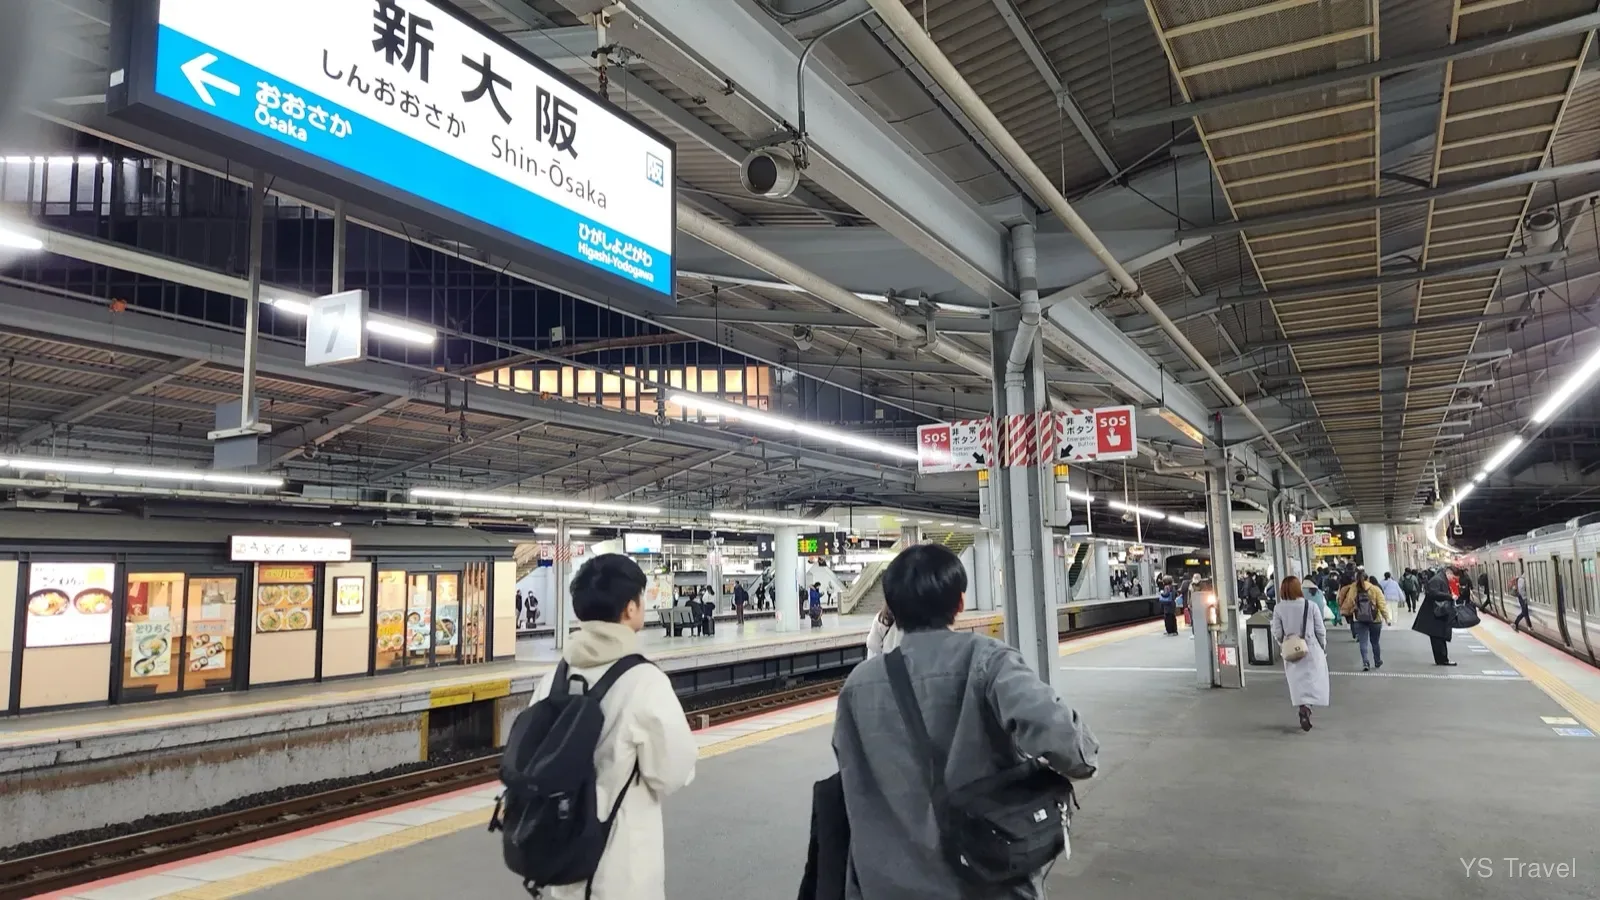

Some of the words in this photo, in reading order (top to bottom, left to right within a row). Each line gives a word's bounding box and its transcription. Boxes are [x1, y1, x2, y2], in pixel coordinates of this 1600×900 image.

[372, 0, 580, 160] 新大阪
[254, 104, 308, 143] Ōsaka
[255, 81, 353, 139] おおさか
[322, 48, 466, 139] しんおおさか
[491, 134, 607, 210] Shin-Ōsaka
[578, 222, 653, 268] ひがしよどがわ
[578, 241, 654, 283] Higashi-Yodogawa
[322, 303, 346, 354] 7
[924, 432, 947, 443] SOS
[952, 436, 977, 445] ボタン
[1067, 426, 1094, 435] ボタン
[1100, 416, 1127, 428] SOS
[761, 542, 767, 551] 5
[1346, 531, 1356, 540] 8
